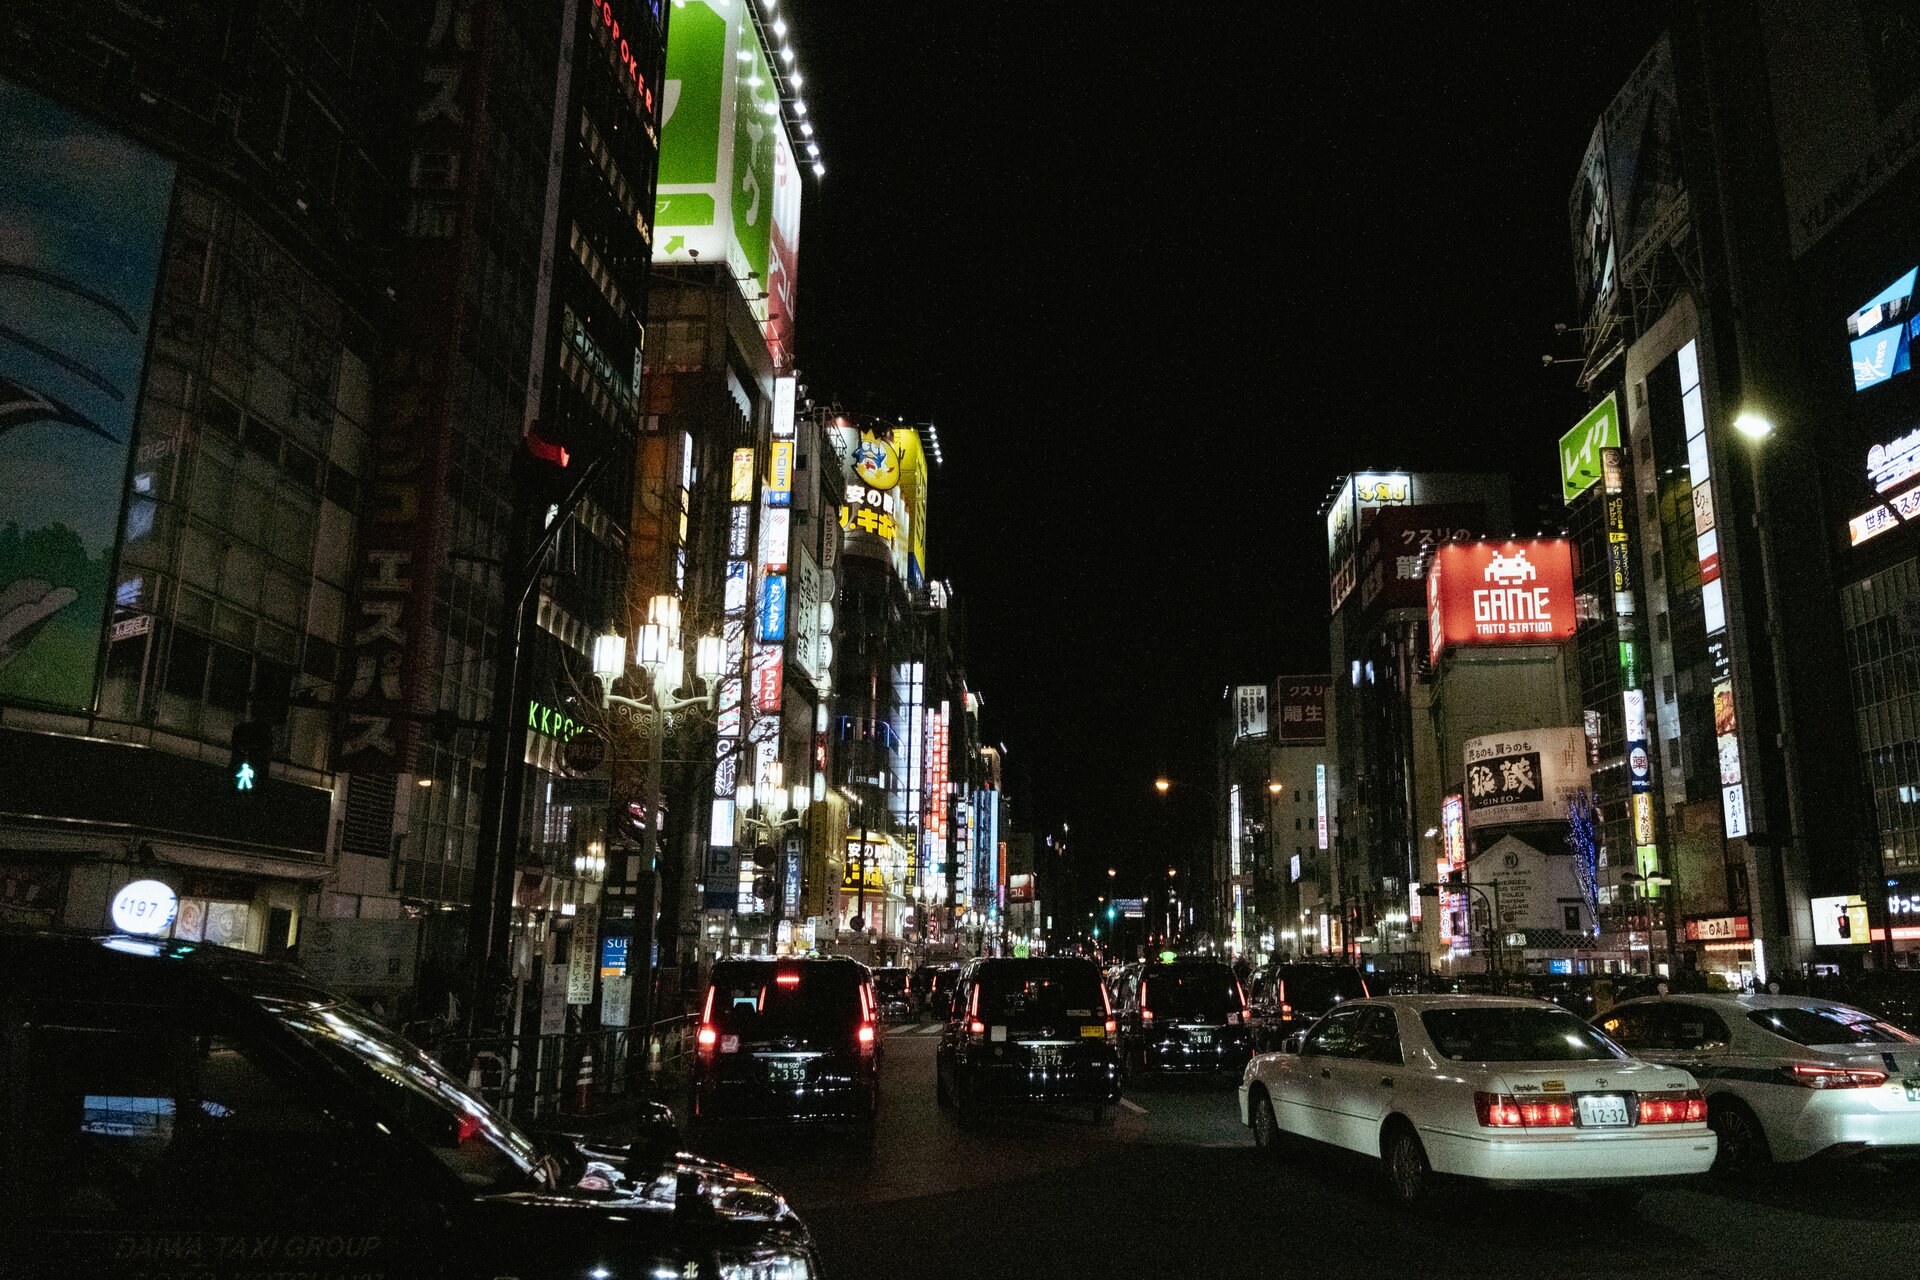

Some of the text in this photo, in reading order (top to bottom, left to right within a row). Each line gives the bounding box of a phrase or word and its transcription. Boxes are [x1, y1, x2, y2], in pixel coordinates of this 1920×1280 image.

[596, 0, 653, 113] GPOKER
[776, 448, 788, 487] プロミス
[774, 492, 788, 502] 6F
[769, 584, 781, 632] セントラル
[1473, 587, 1550, 622] GAME
[1476, 621, 1552, 634] TAITO STATION
[342, 549, 413, 757] エスパス
[764, 670, 777, 700] アコム
[1289, 685, 1324, 697] クスリ
[529, 700, 594, 743] KKPO
[1495, 742, 1532, 756] 買うのも
[1632, 755, 1647, 769] 薬
[120, 898, 158, 918] 4197
[1592, 1108, 1627, 1123] 12-32
[284, 1235, 382, 1259] GROUP
